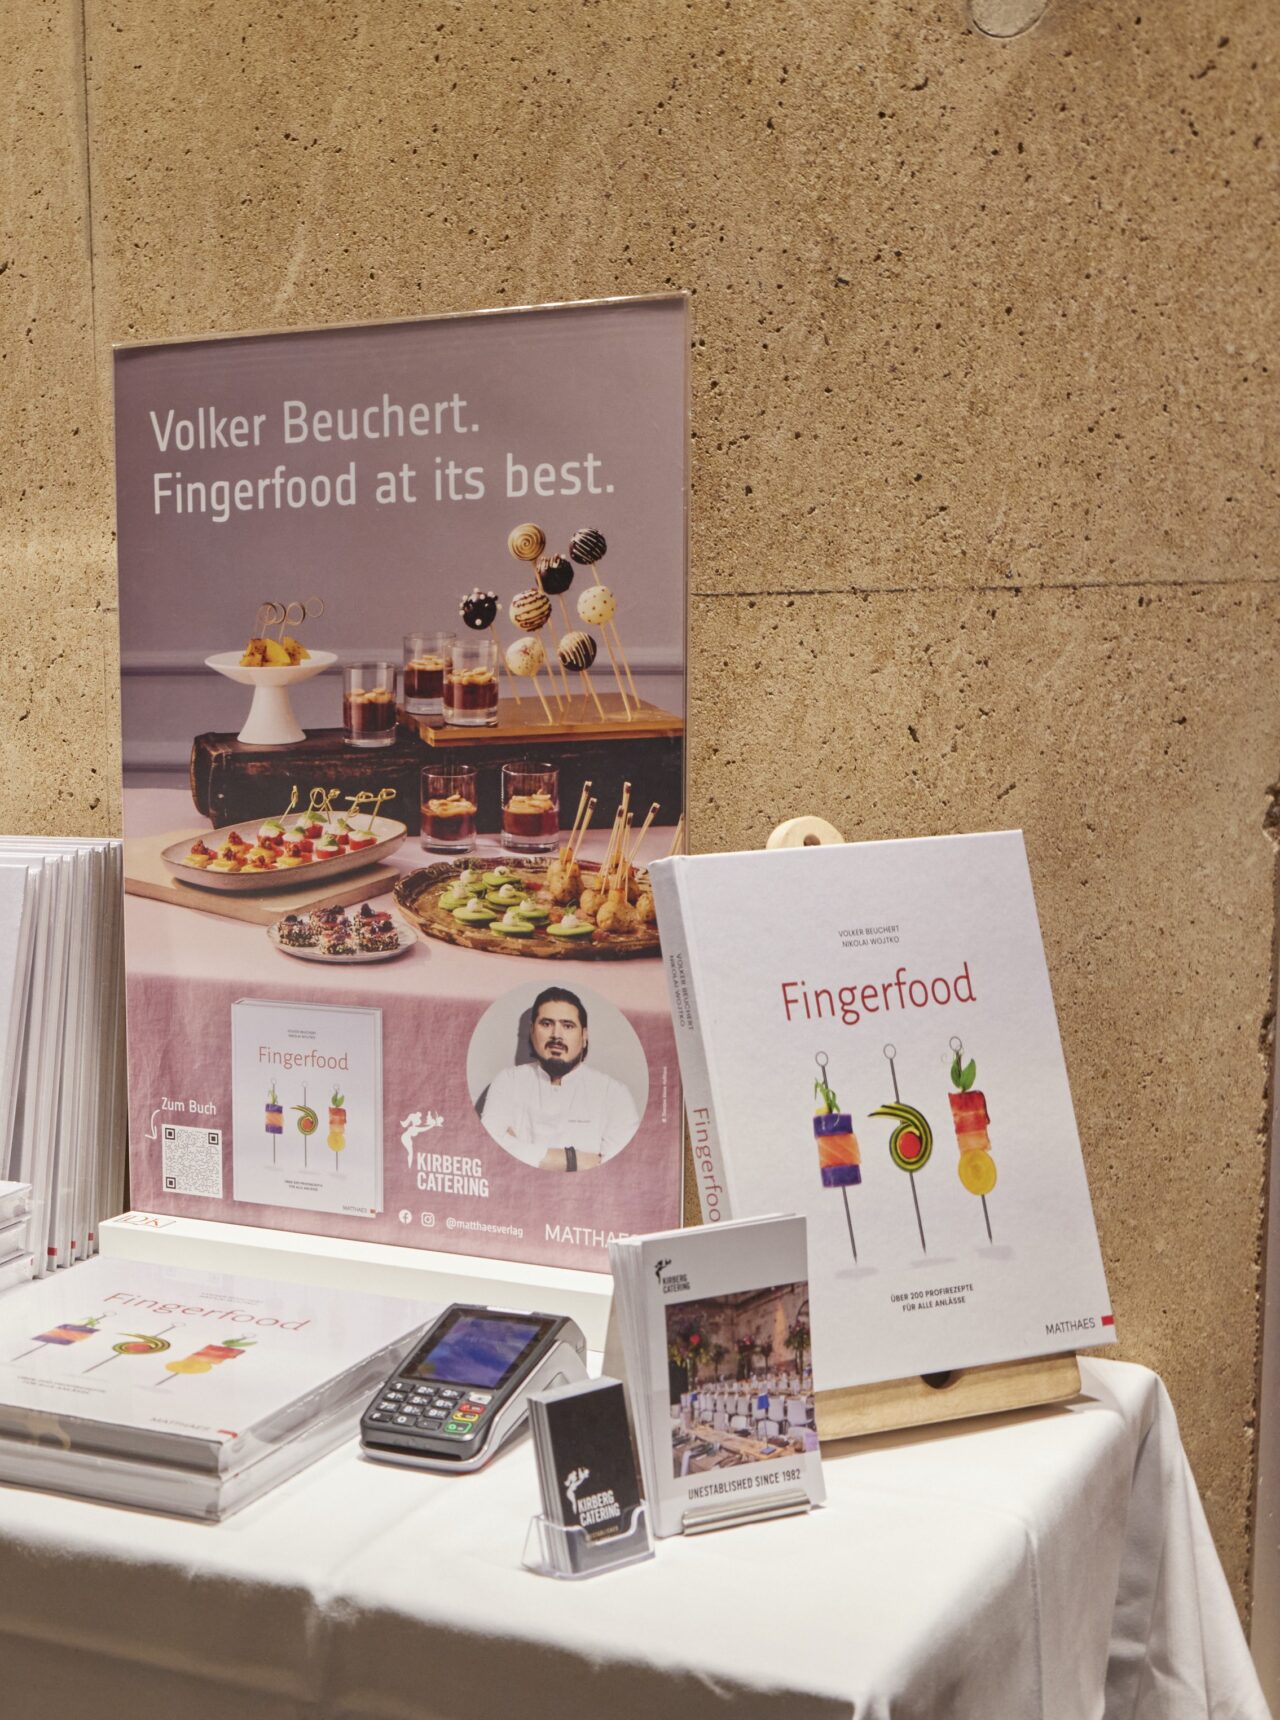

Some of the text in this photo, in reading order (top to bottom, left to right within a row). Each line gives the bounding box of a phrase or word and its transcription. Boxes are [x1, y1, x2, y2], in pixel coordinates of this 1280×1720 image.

[150, 393, 479, 452] Volker Beuchert.
[153, 452, 615, 522] Fingerfood at its best.
[838, 925, 900, 938] VOLKER BEUCHERT
[842, 935, 900, 948] NIKOLAI WOJTKO
[781, 961, 977, 1026] Fingerfood
[258, 1046, 350, 1071] Fingerfood
[161, 1096, 216, 1115] Zum Buch
[417, 1152, 482, 1177] KIRBERG
[693, 1107, 722, 1223] Fingerfoo
[417, 1171, 489, 1198] CATERING
[446, 1217, 523, 1239] @matthaesverlag
[662, 1274, 688, 1285] KIRBERG
[663, 1281, 691, 1294] CATERING
[890, 1283, 974, 1303] ÜBER 200 PROFIREZEPTE
[902, 1295, 966, 1313] FÜR ALLE ANLÄSSE
[104, 1292, 311, 1330] Fingerfood
[1045, 1317, 1097, 1336] MATTHAES
[688, 1468, 801, 1500] UNESTABLISHED SINCE 1982
[577, 1489, 615, 1514] KIRBERG
[579, 1503, 621, 1527] CATERING
